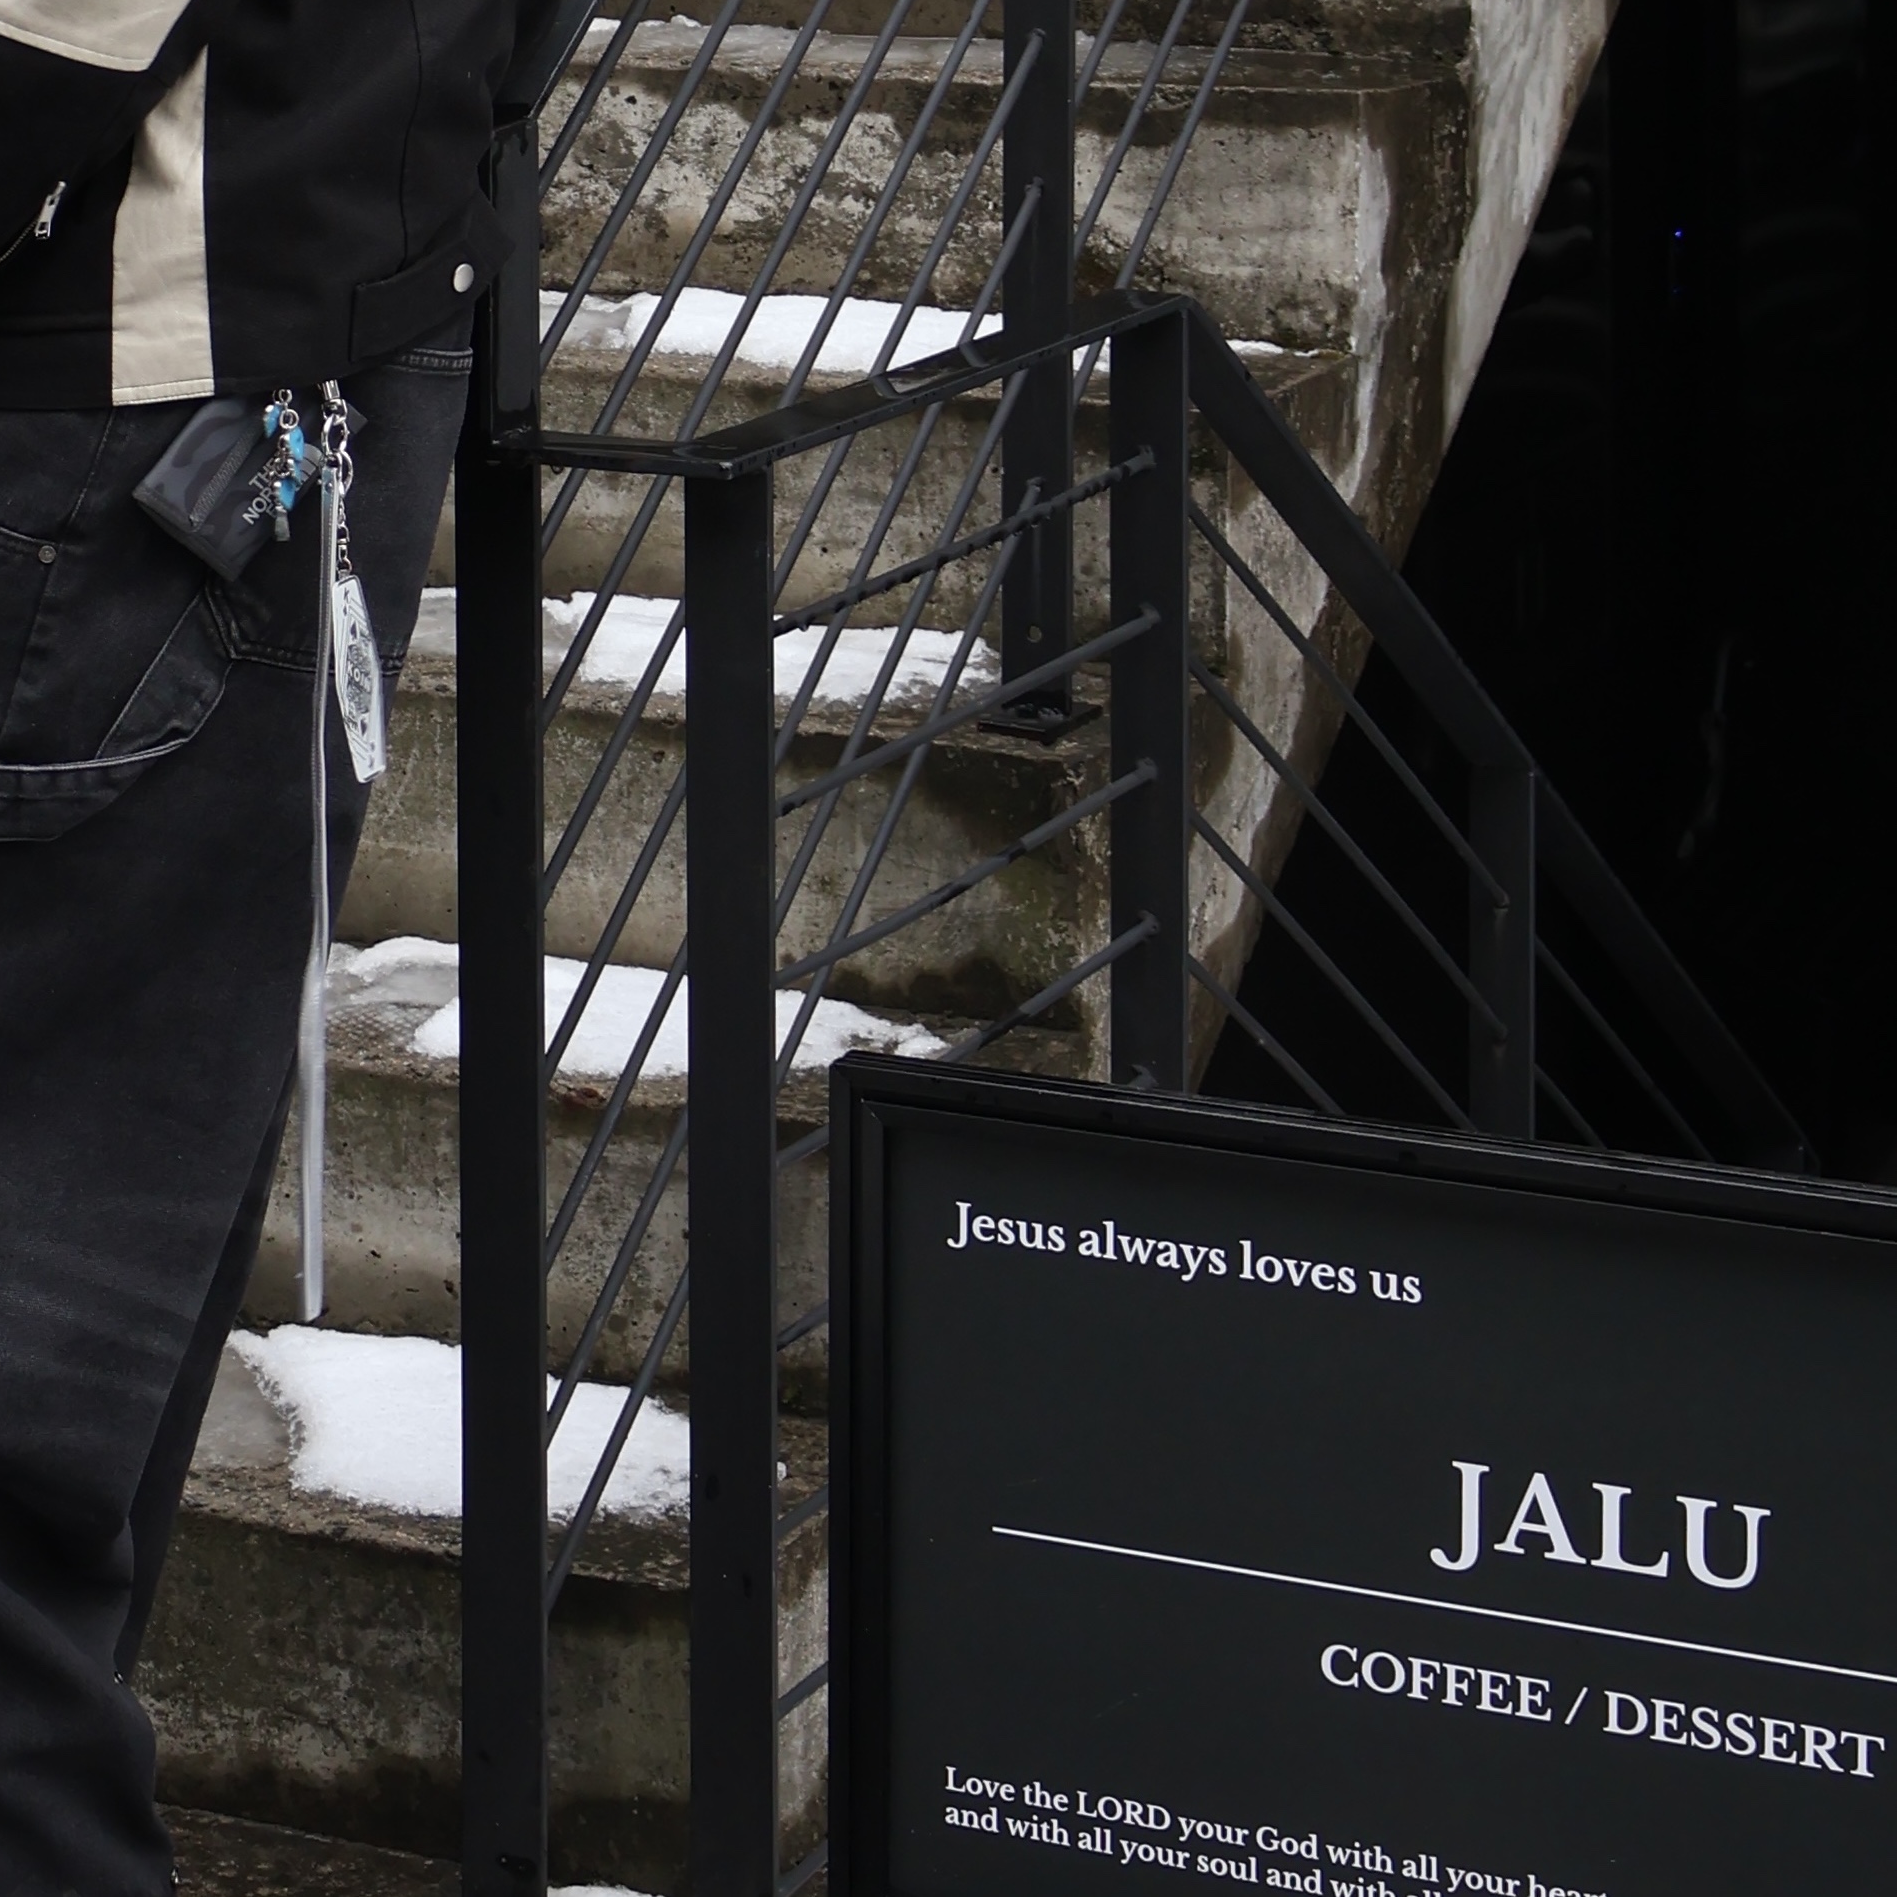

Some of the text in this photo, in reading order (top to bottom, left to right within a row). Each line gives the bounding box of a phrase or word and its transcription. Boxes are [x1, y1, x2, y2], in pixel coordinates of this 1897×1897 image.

[946, 1201, 1422, 1304] Jesus always loves us
[1429, 1460, 1772, 1590] JALU
[1320, 1644, 1886, 1778] COFFEE / DESSERT
[944, 1806, 1396, 1897] and with all your soul and with
[945, 1765, 1016, 1802] Love
[1022, 1781, 1069, 1812] the
[1076, 1790, 1171, 1830] LORD
[1177, 1816, 1250, 1847] your
[1255, 1826, 1320, 1861] God
[1325, 1841, 1395, 1875] with
[1401, 1854, 1440, 1883] all
[1445, 1866, 1521, 1897] your
